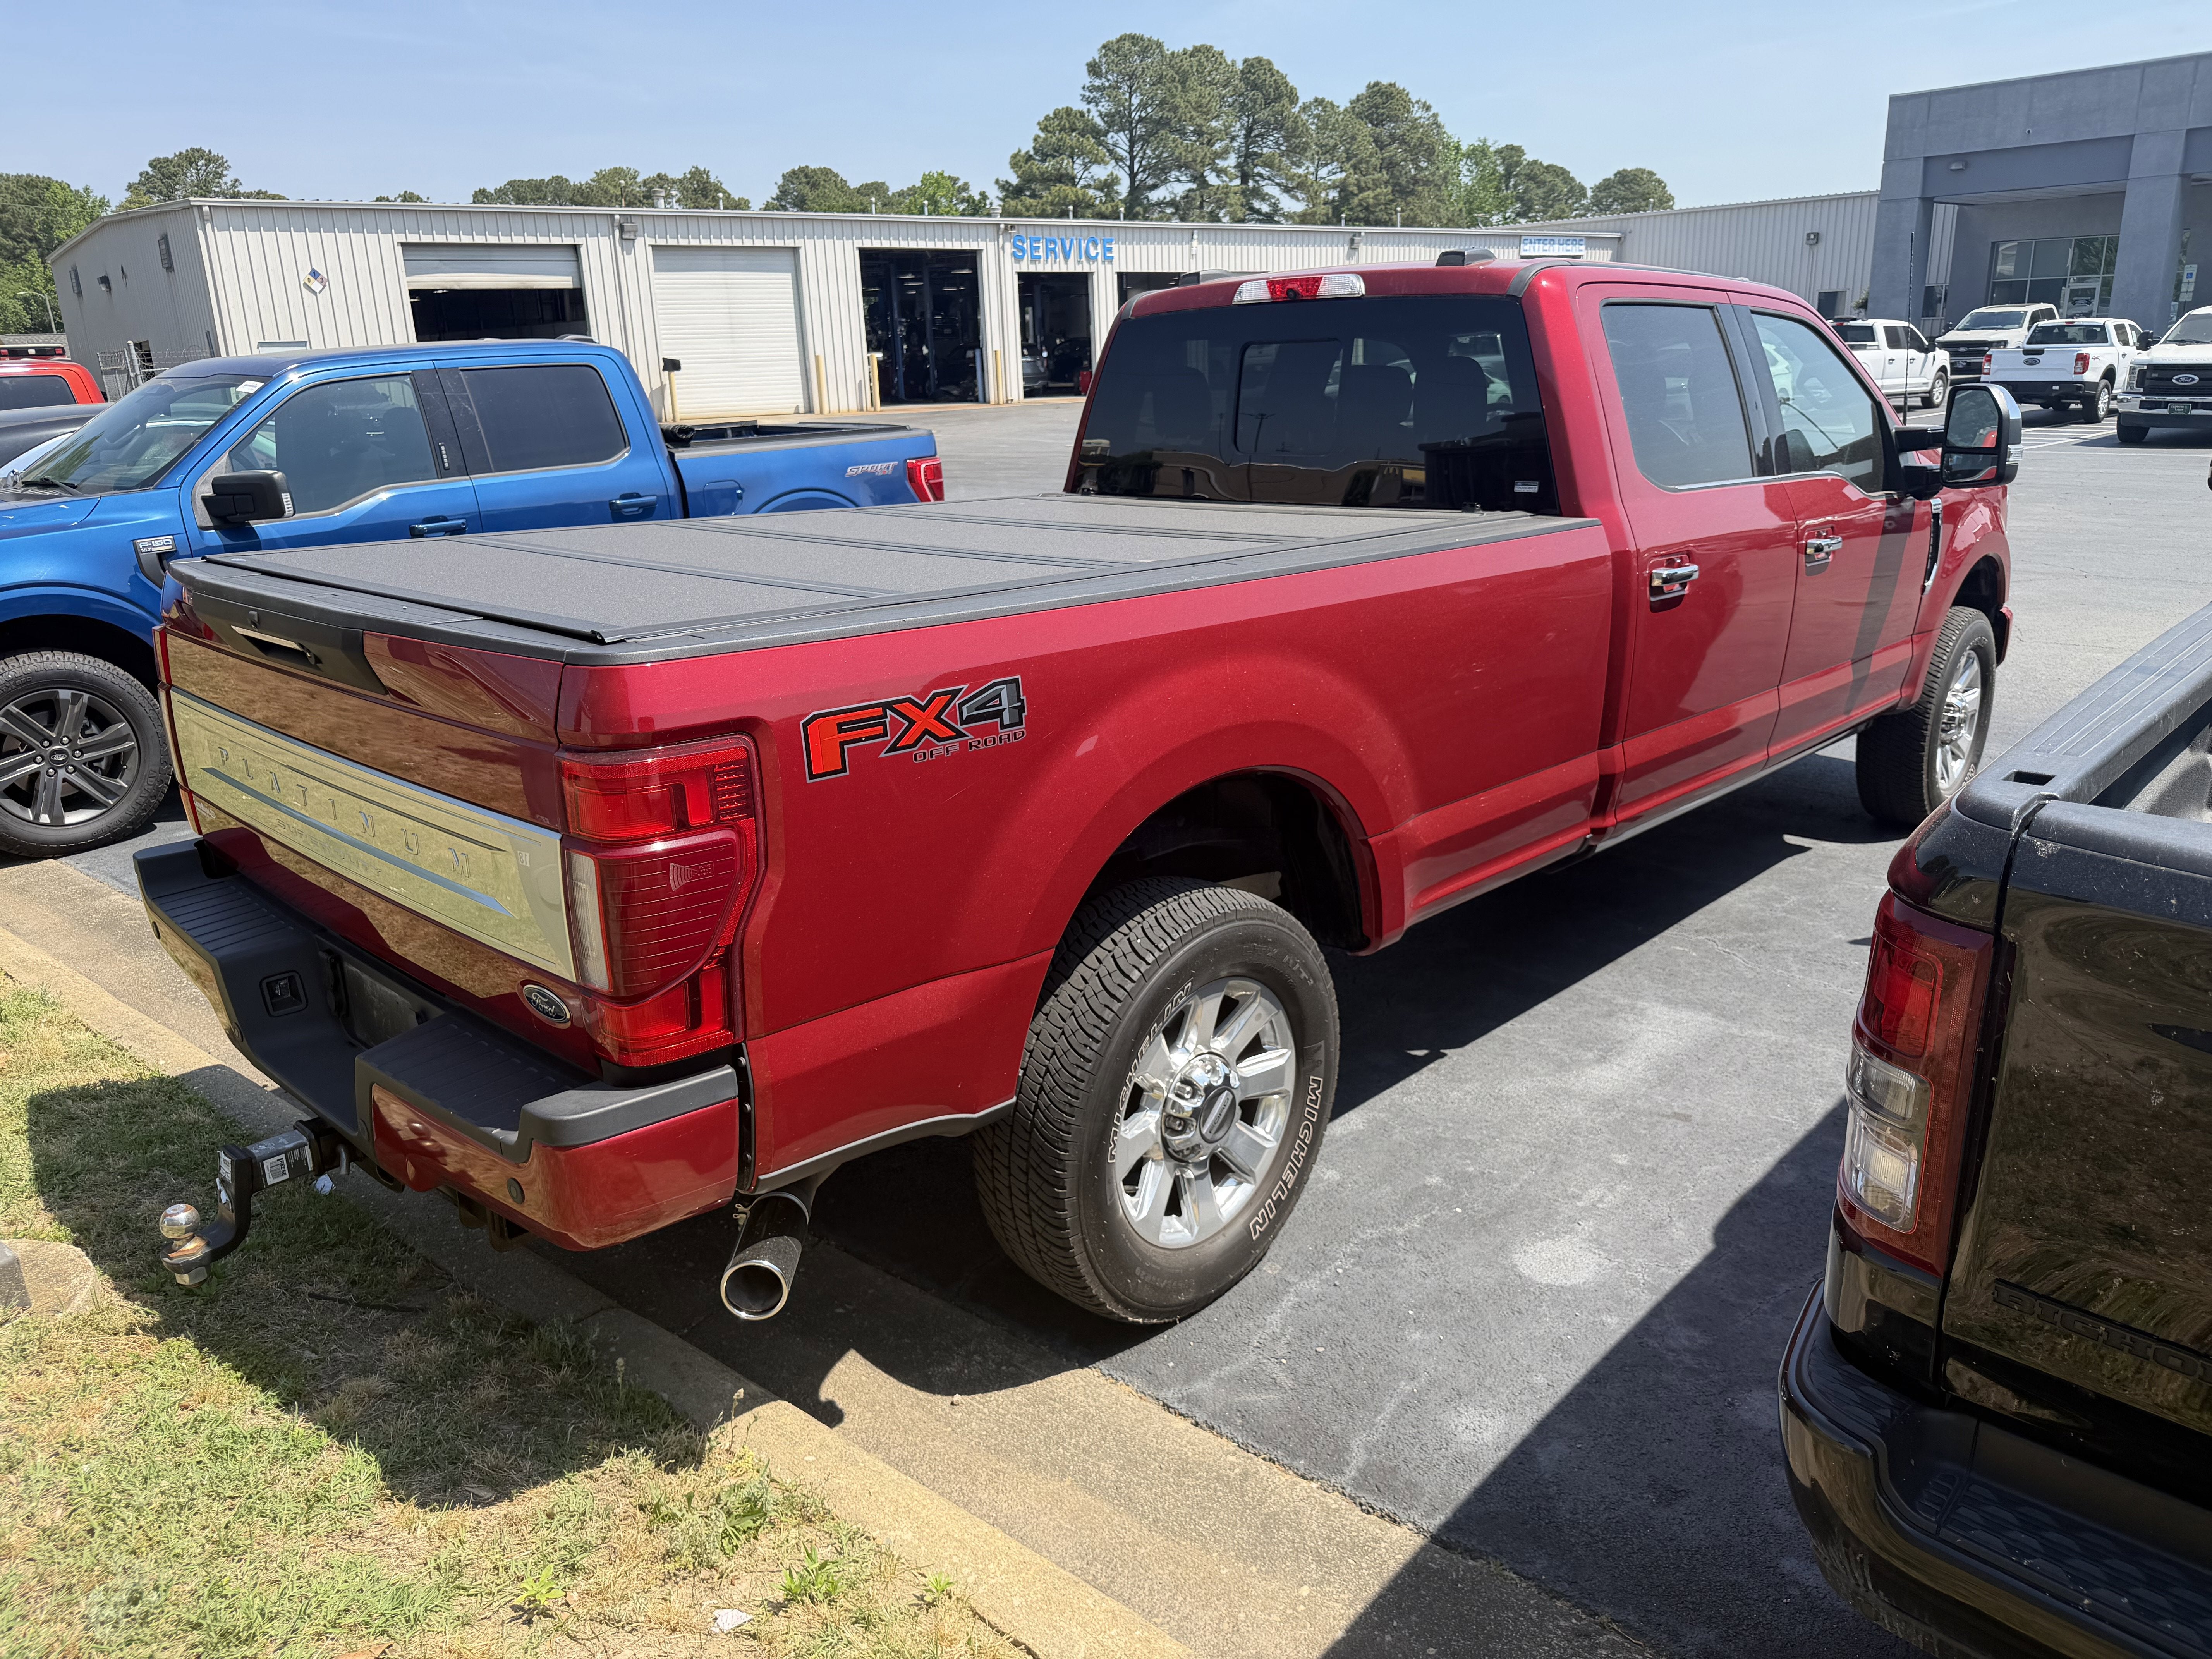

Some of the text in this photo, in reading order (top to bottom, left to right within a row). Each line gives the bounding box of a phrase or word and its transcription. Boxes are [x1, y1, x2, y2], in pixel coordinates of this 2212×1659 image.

[1012, 235, 1115, 261] SERVICE
[1523, 239, 1583, 252] ENTER HERE
[845, 462, 898, 477] SPORT
[139, 539, 173, 548] F-150
[800, 675, 1027, 783] FX4
[913, 730, 1027, 763] OFF ROAD
[218, 746, 470, 878] PLATINUM
[531, 993, 556, 1017] Ford
[1249, 1075, 1323, 1240] MICHELIN
[1992, 1278, 2212, 1385] BIGHO
